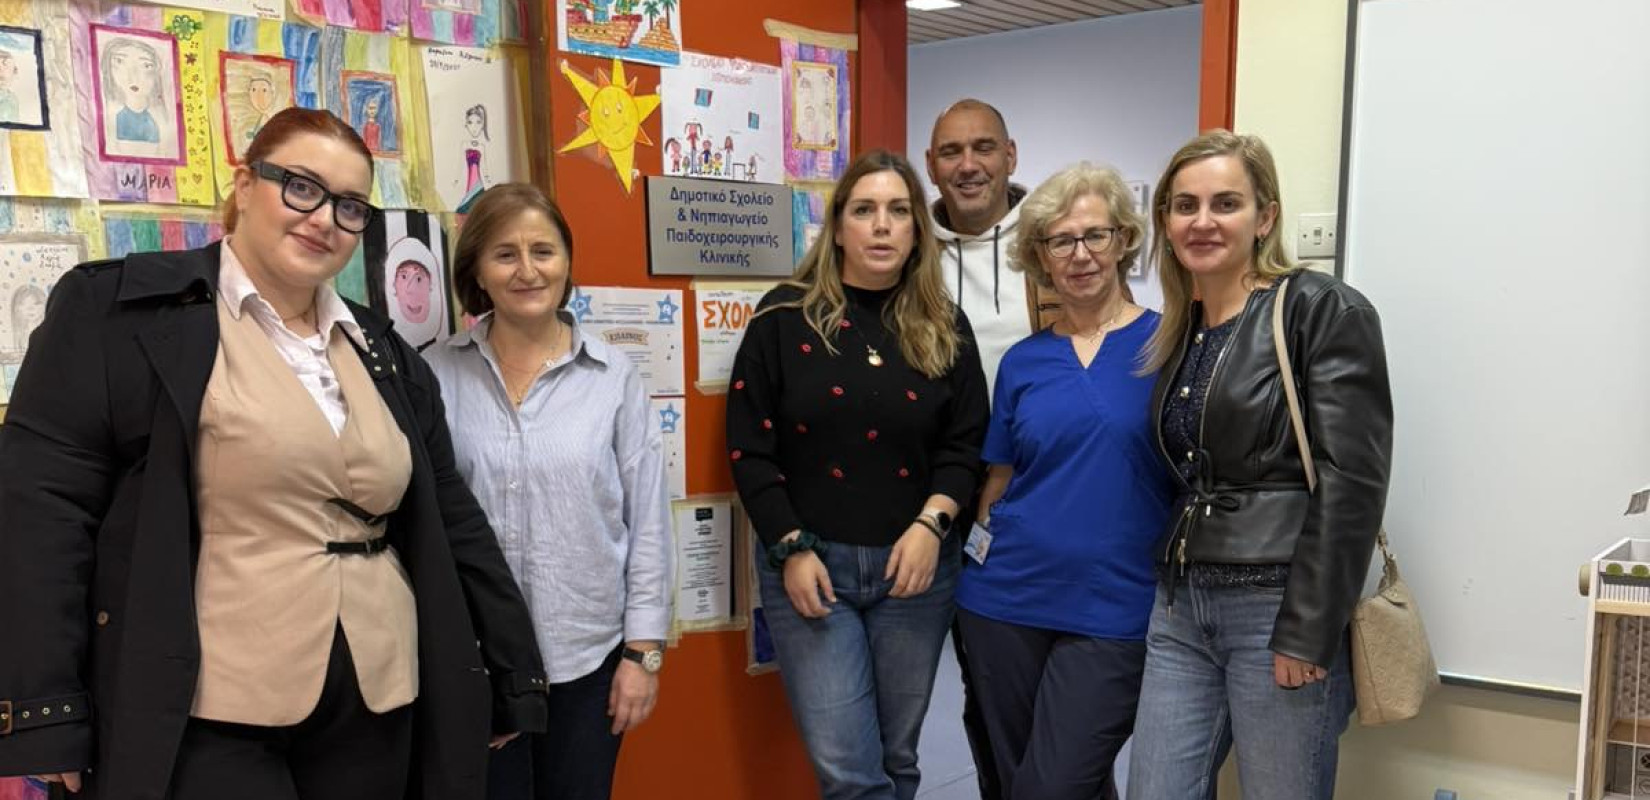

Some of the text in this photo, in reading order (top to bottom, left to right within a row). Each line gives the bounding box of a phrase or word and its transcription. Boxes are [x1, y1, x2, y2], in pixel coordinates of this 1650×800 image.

[120, 173, 172, 190] ΜΑΡΙΑ
[670, 187, 774, 207] Δημοτικό Σχολείο
[677, 208, 768, 226] & Νηπιαγωγείο
[666, 228, 779, 248] Παιδοχειρουργικής
[700, 250, 751, 267] Κλινικής
[702, 300, 755, 330] ΣΧΟΛ
